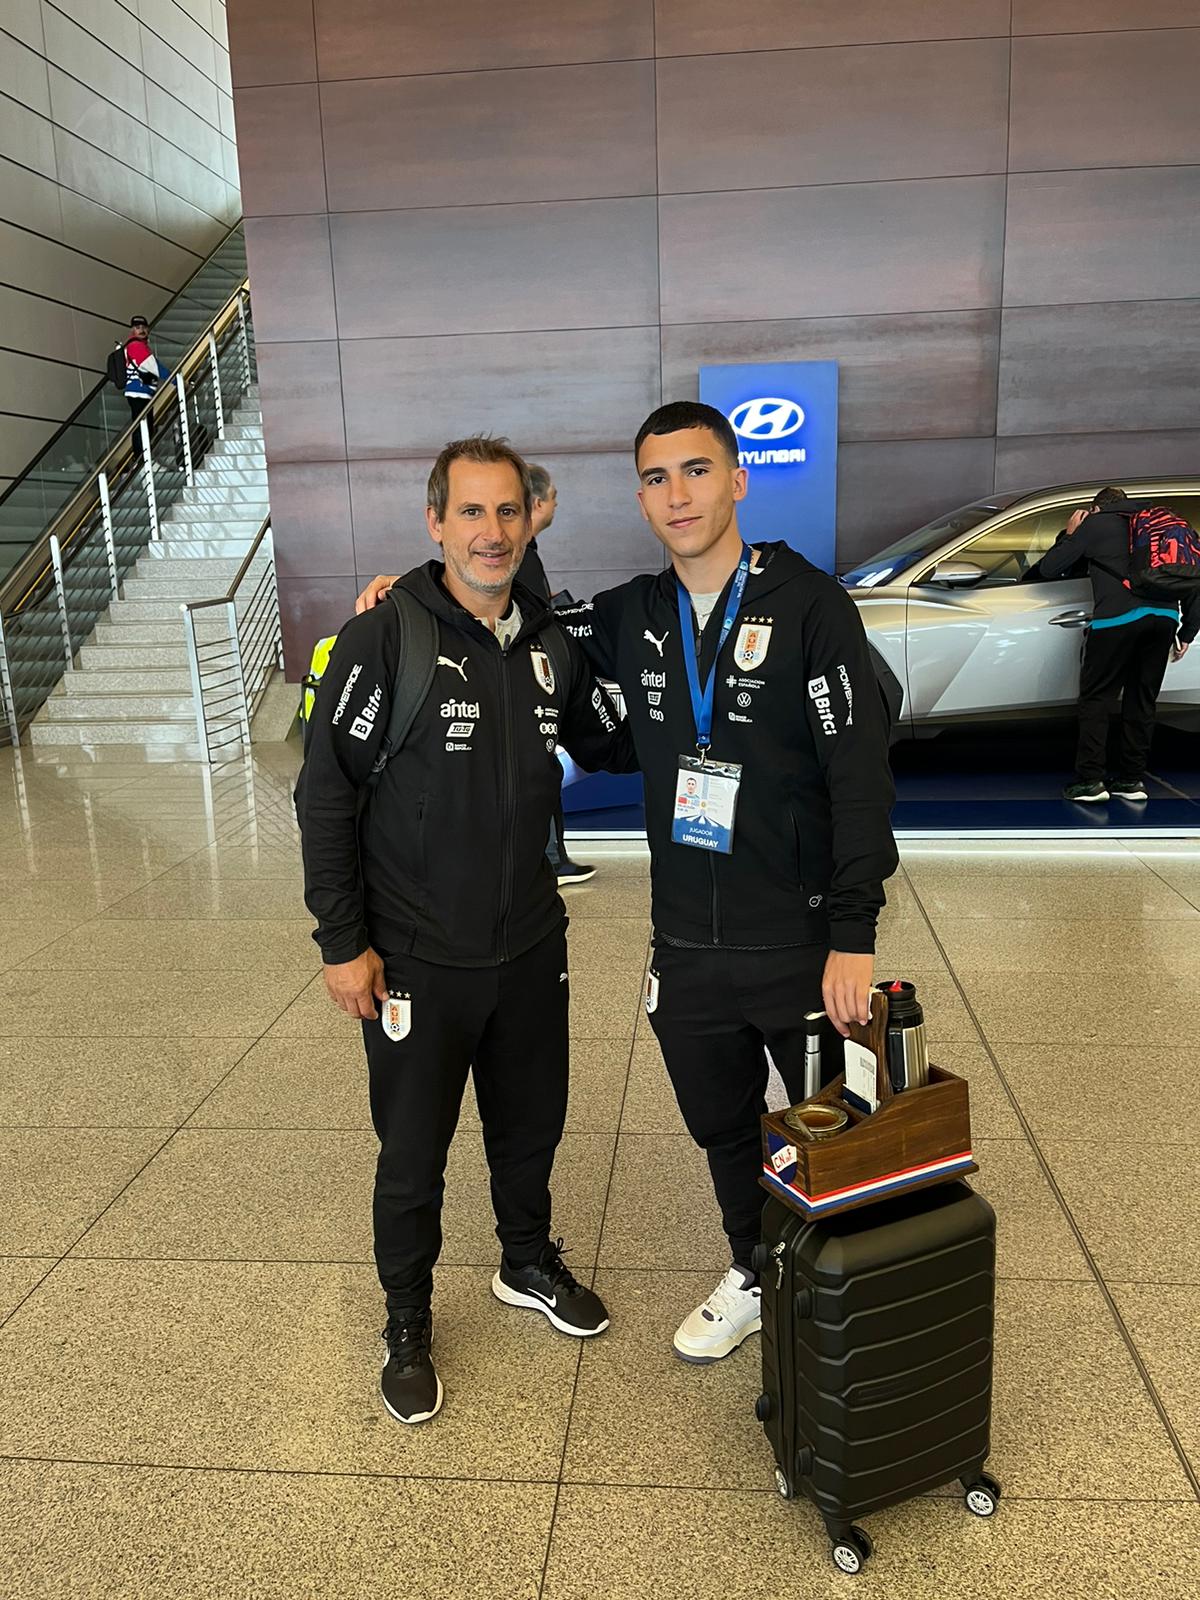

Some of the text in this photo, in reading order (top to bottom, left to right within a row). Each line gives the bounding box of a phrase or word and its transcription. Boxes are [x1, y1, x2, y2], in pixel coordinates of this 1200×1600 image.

[640, 669, 666, 688] antel
[331, 664, 363, 725] POWERADE
[361, 683, 382, 722] Bitci
[836, 664, 853, 726] POWEE
[440, 698, 480, 719] antel
[598, 705, 616, 732] Bitci
[814, 697, 838, 735] Bitci
[682, 834, 719, 848] URUGUAY
[689, 827, 713, 836] JUGADOR
